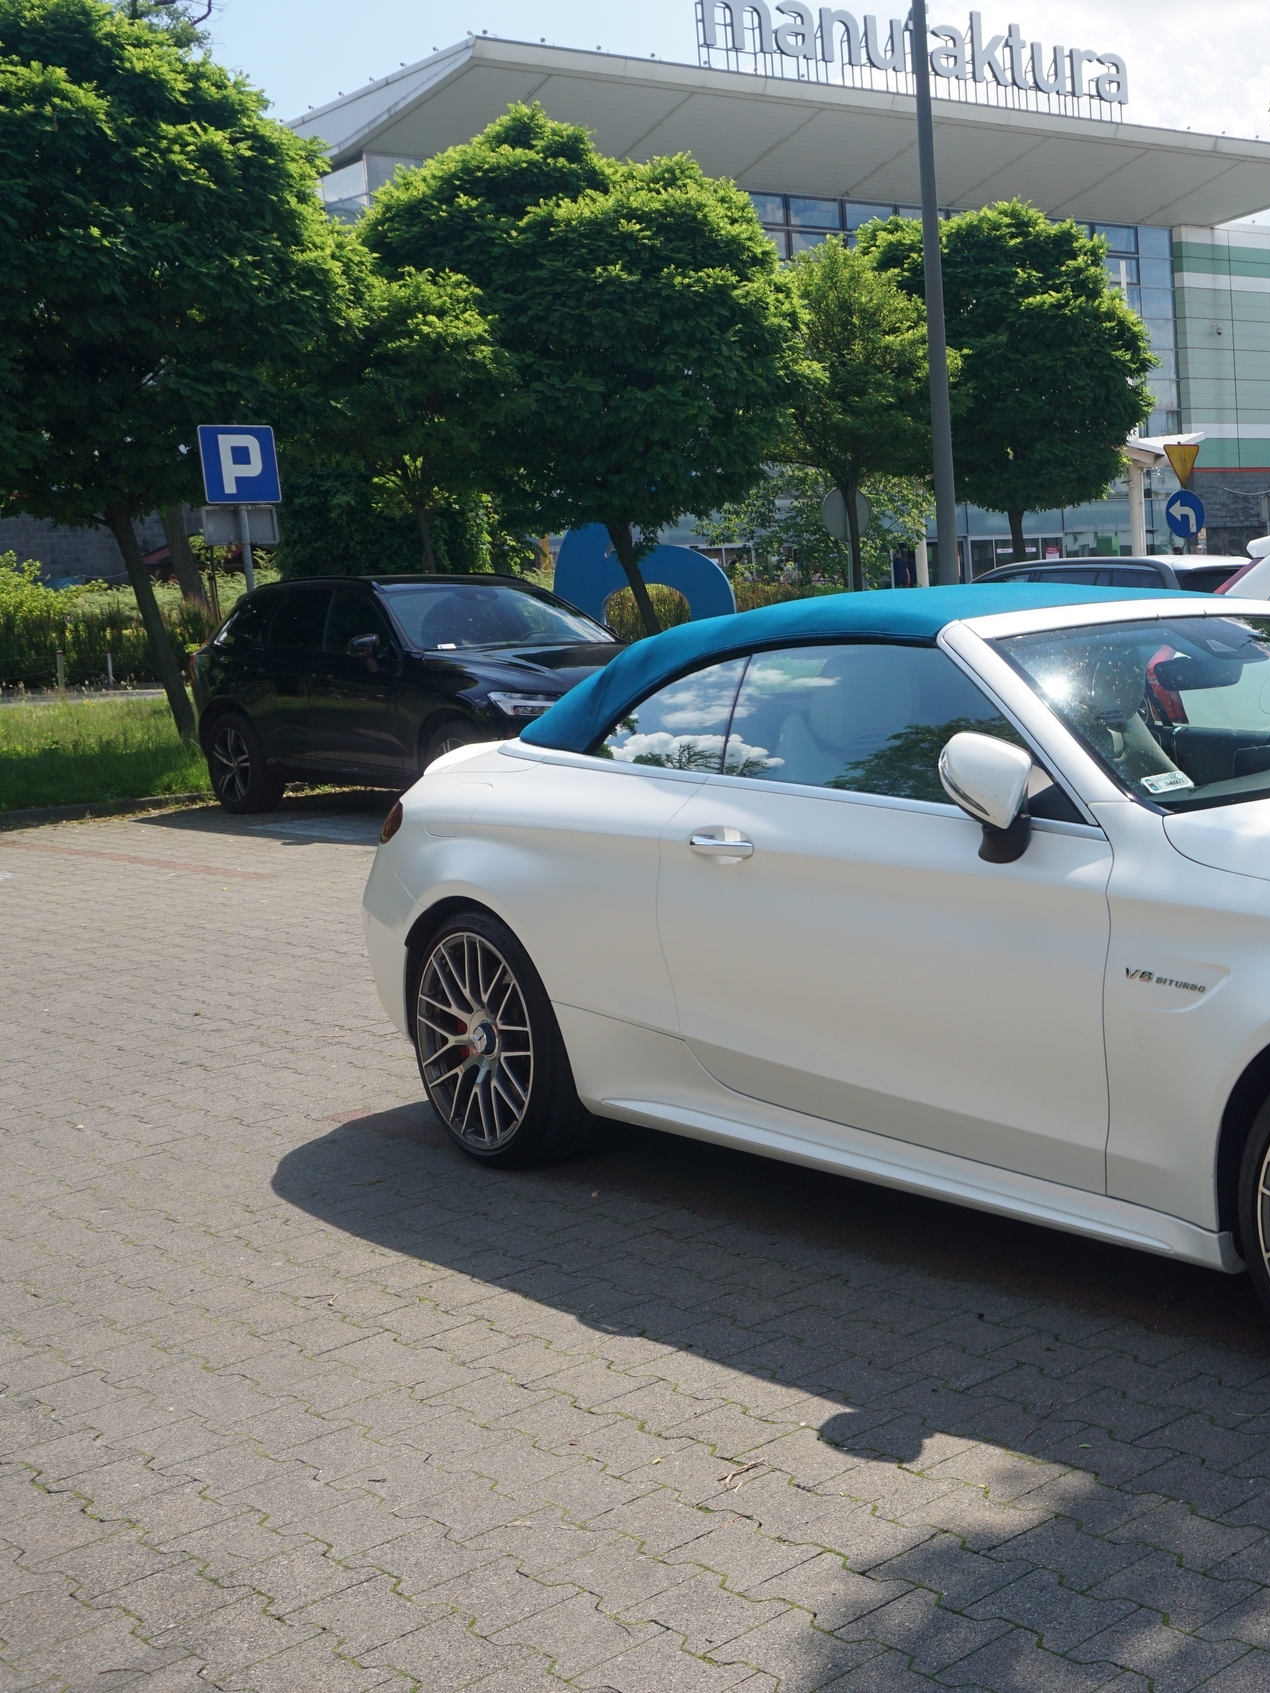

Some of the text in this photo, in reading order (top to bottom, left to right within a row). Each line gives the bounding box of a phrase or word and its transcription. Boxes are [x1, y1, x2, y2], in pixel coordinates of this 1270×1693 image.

[217, 434, 263, 494] P
[1125, 967, 1206, 992] V8 BITURBO
